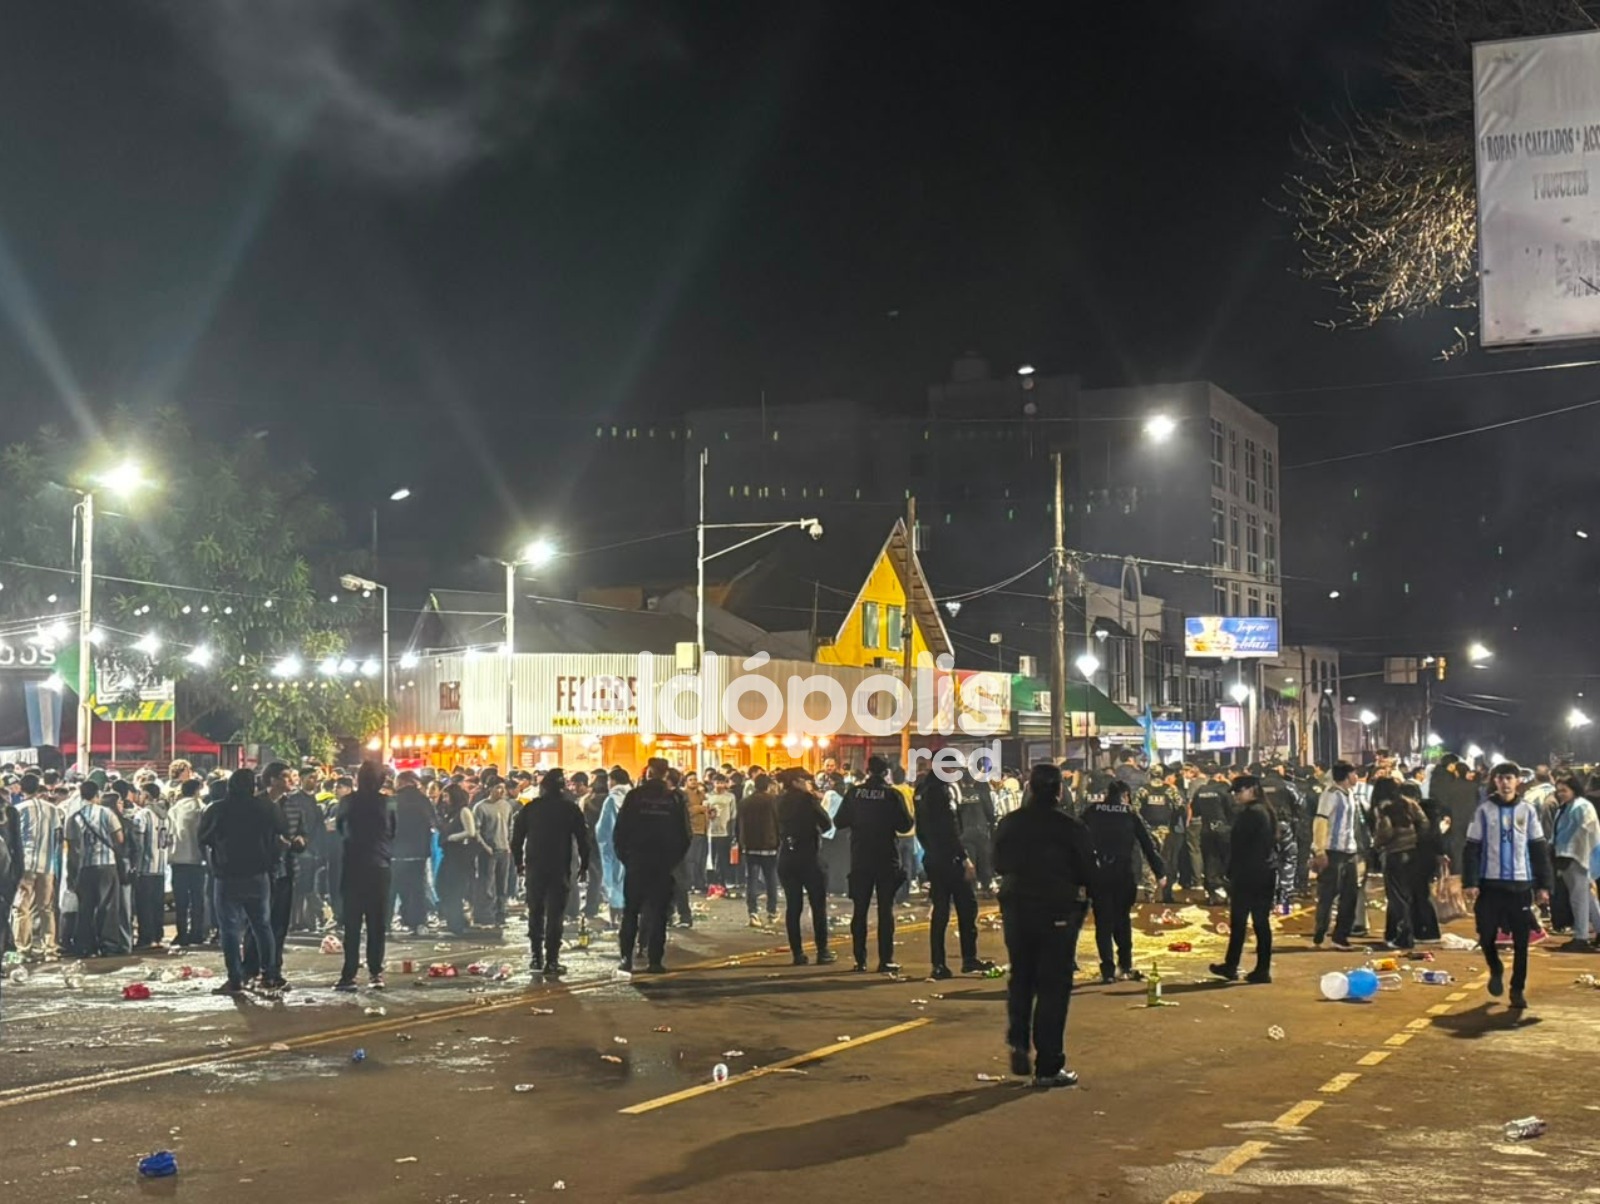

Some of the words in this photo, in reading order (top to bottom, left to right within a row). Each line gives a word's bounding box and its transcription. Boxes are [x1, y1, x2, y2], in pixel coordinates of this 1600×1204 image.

[1486, 132, 1517, 162] ROPAS
[1525, 127, 1574, 156] CALZADOS
[1095, 804, 1129, 813] POLICIA
